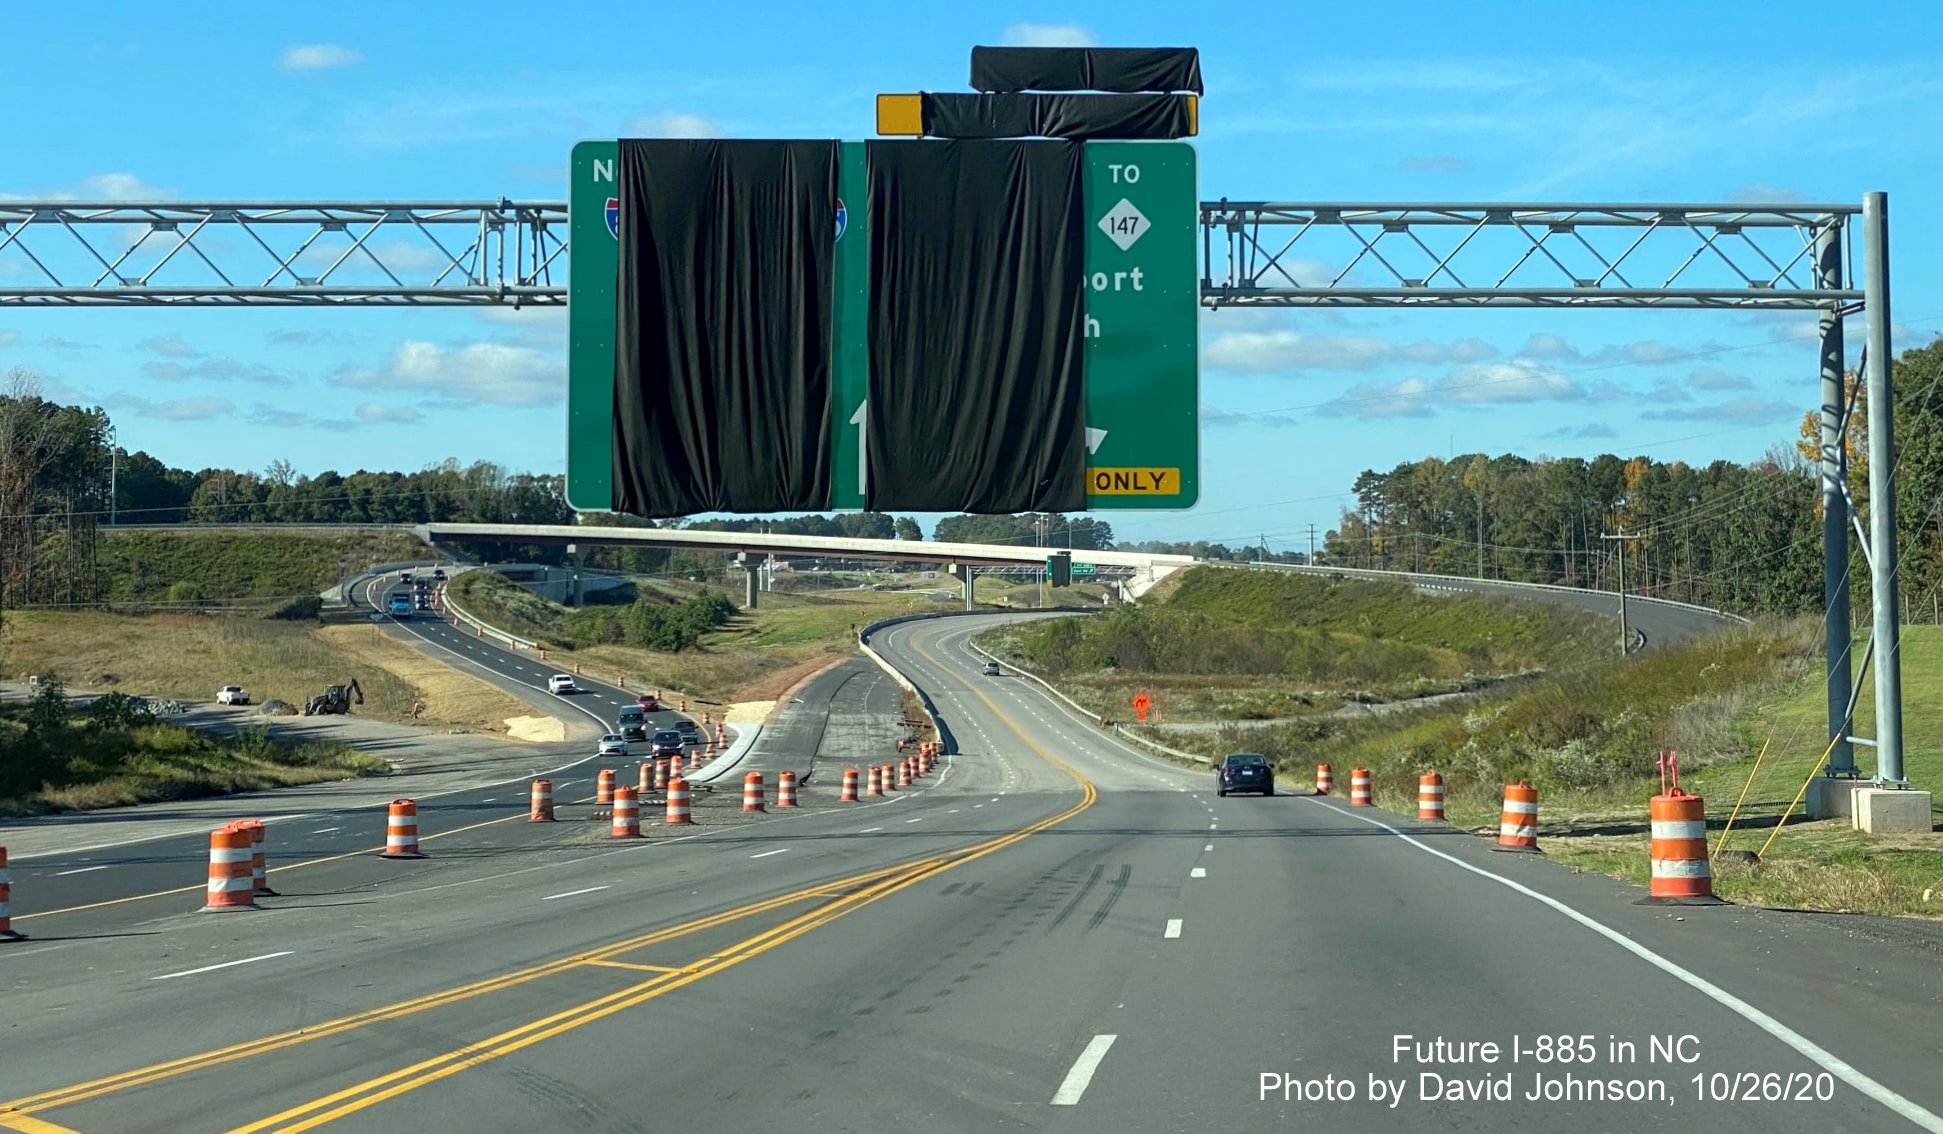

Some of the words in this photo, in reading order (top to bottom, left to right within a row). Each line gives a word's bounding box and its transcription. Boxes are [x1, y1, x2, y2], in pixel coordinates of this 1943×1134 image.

[593, 158, 617, 182] N
[1108, 164, 1140, 184] TO
[1109, 216, 1139, 235] 147
[1083, 266, 1144, 292] ort
[1095, 471, 1166, 491] ONLY
